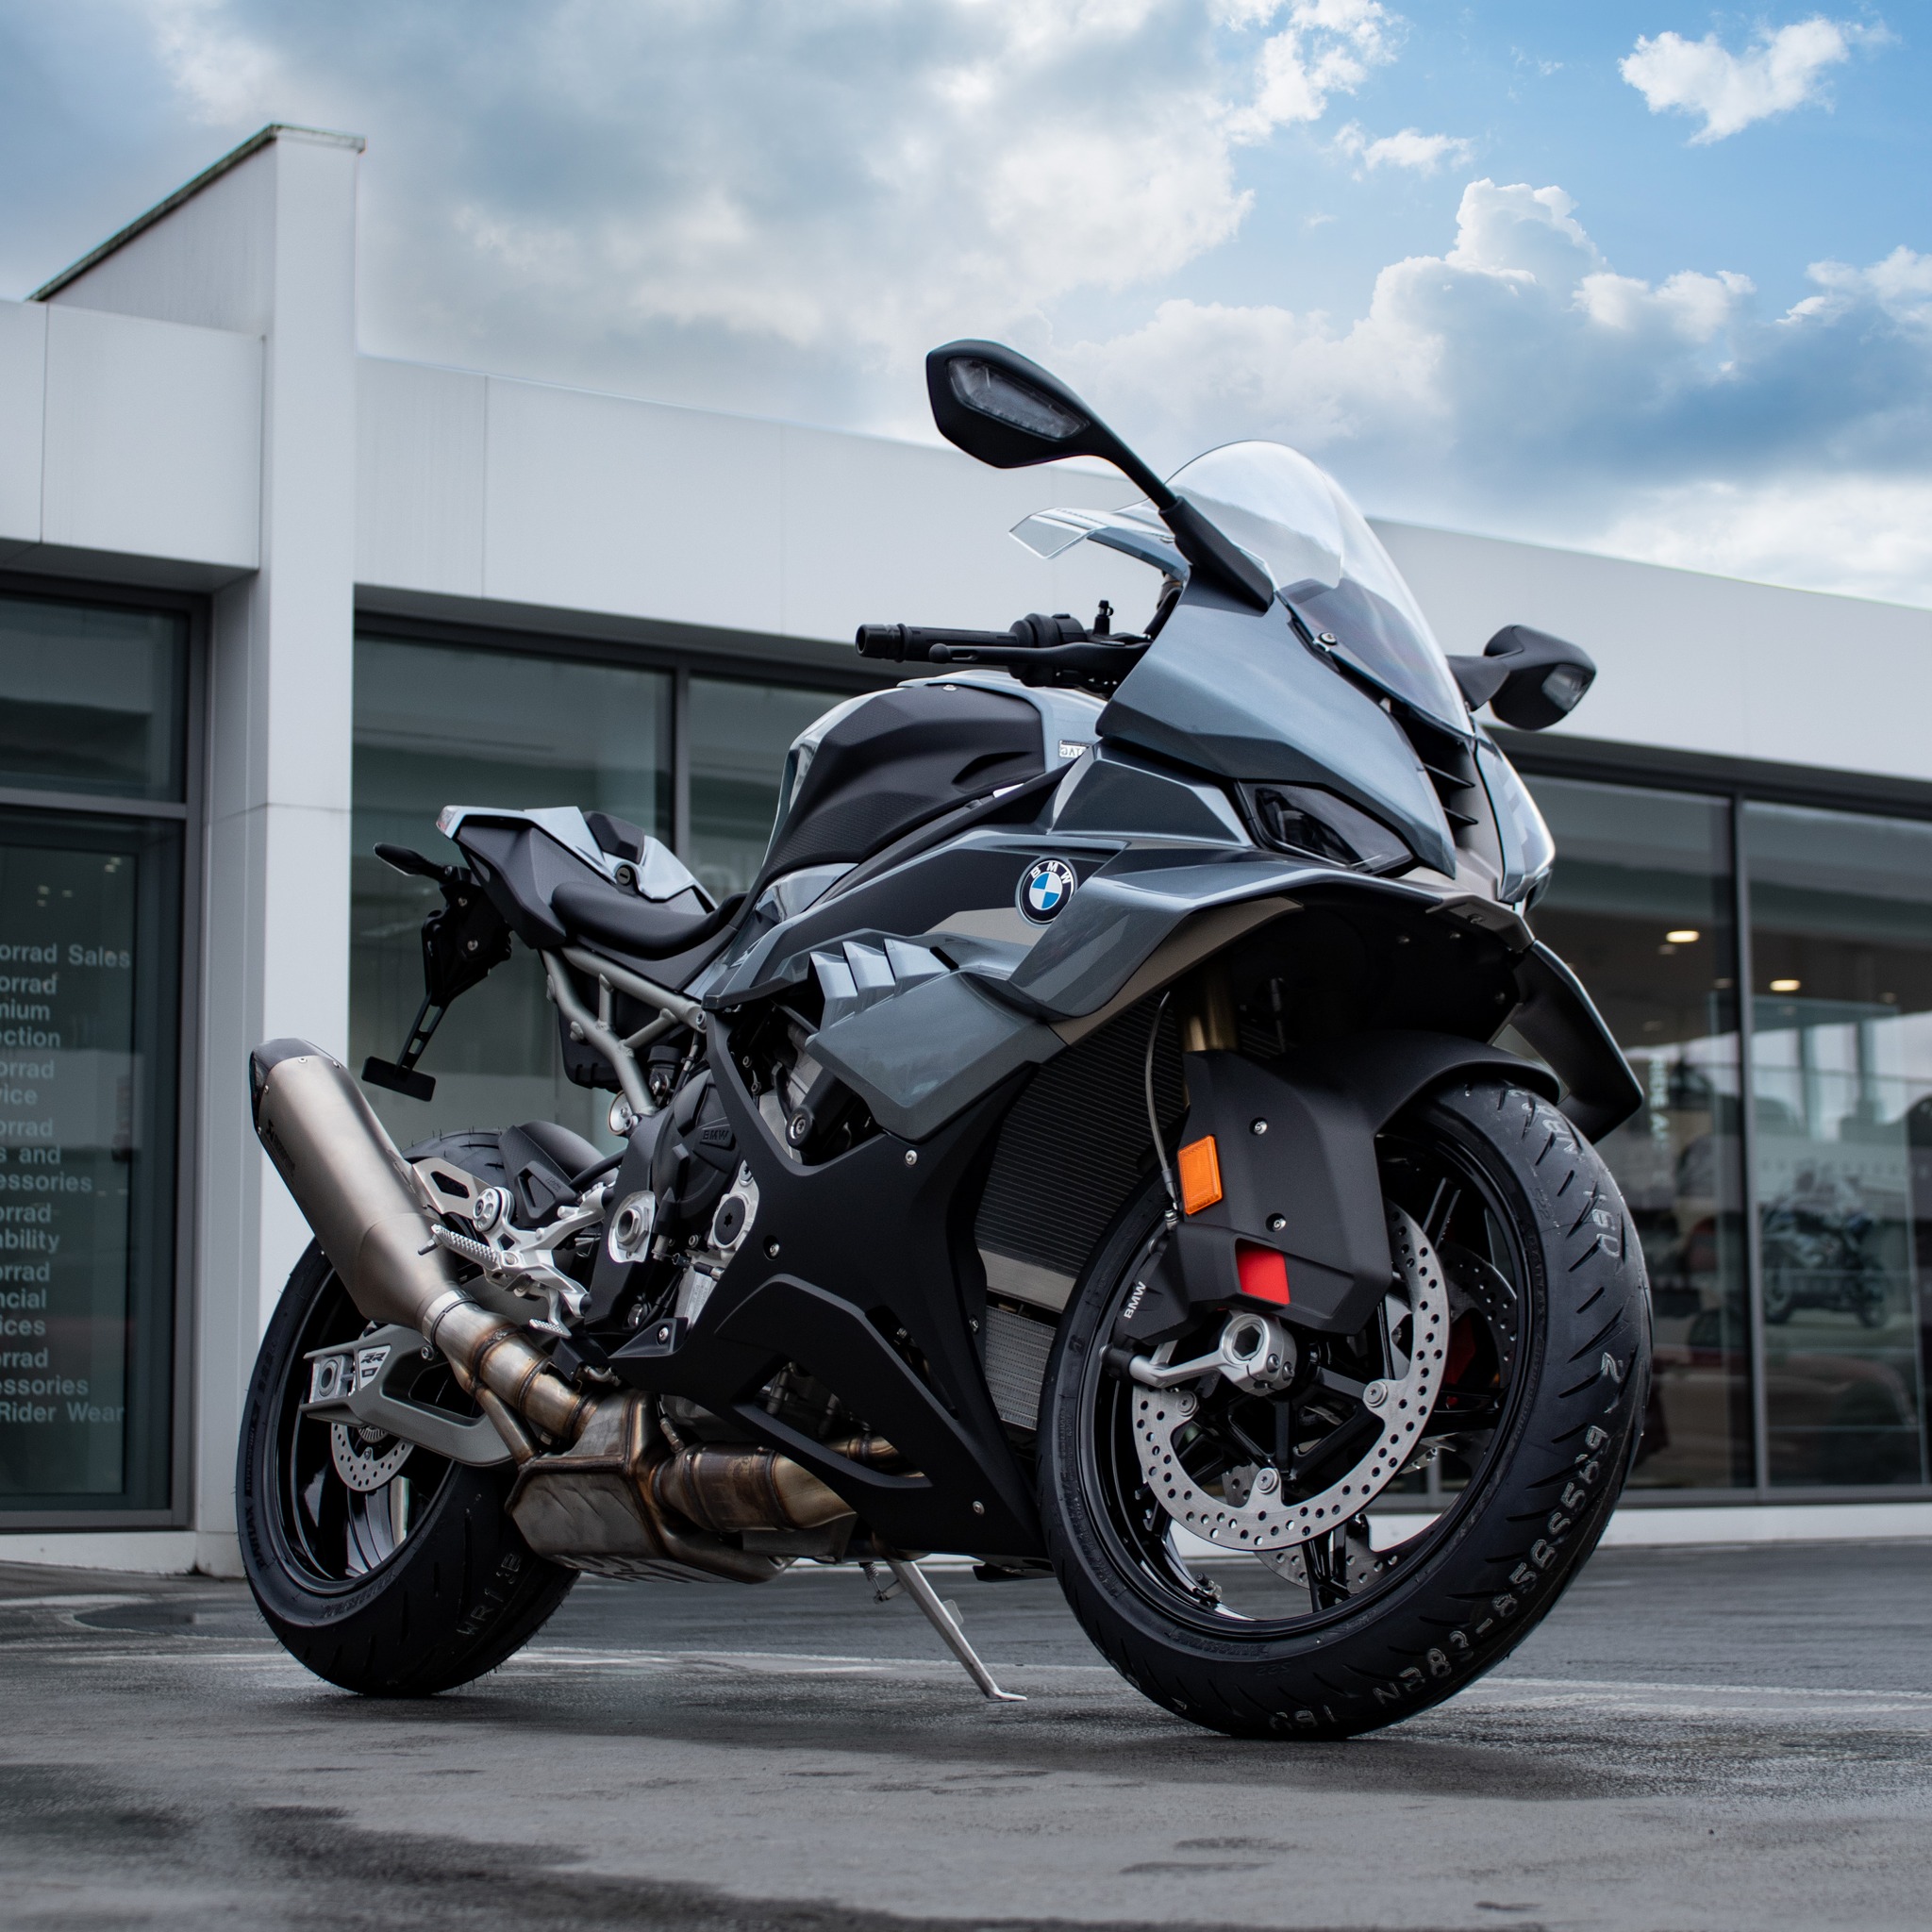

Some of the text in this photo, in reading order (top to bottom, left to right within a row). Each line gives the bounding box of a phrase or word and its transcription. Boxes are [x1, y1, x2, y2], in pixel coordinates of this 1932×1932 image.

[1029, 860, 1072, 885] BMW
[0, 942, 130, 968] orrad Sales
[0, 973, 57, 994] orrad
[0, 1025, 60, 1048] ction
[0, 1083, 38, 1106] ice
[702, 1129, 730, 1141] BMW
[19, 1144, 60, 1164] and
[0, 1228, 59, 1255] bility
[0, 1261, 50, 1282] rrad
[1124, 1280, 1147, 1319] BMW
[0, 1346, 49, 1368] rrad
[0, 1374, 89, 1397] ssories
[0, 1401, 125, 1424] Rider Wear
